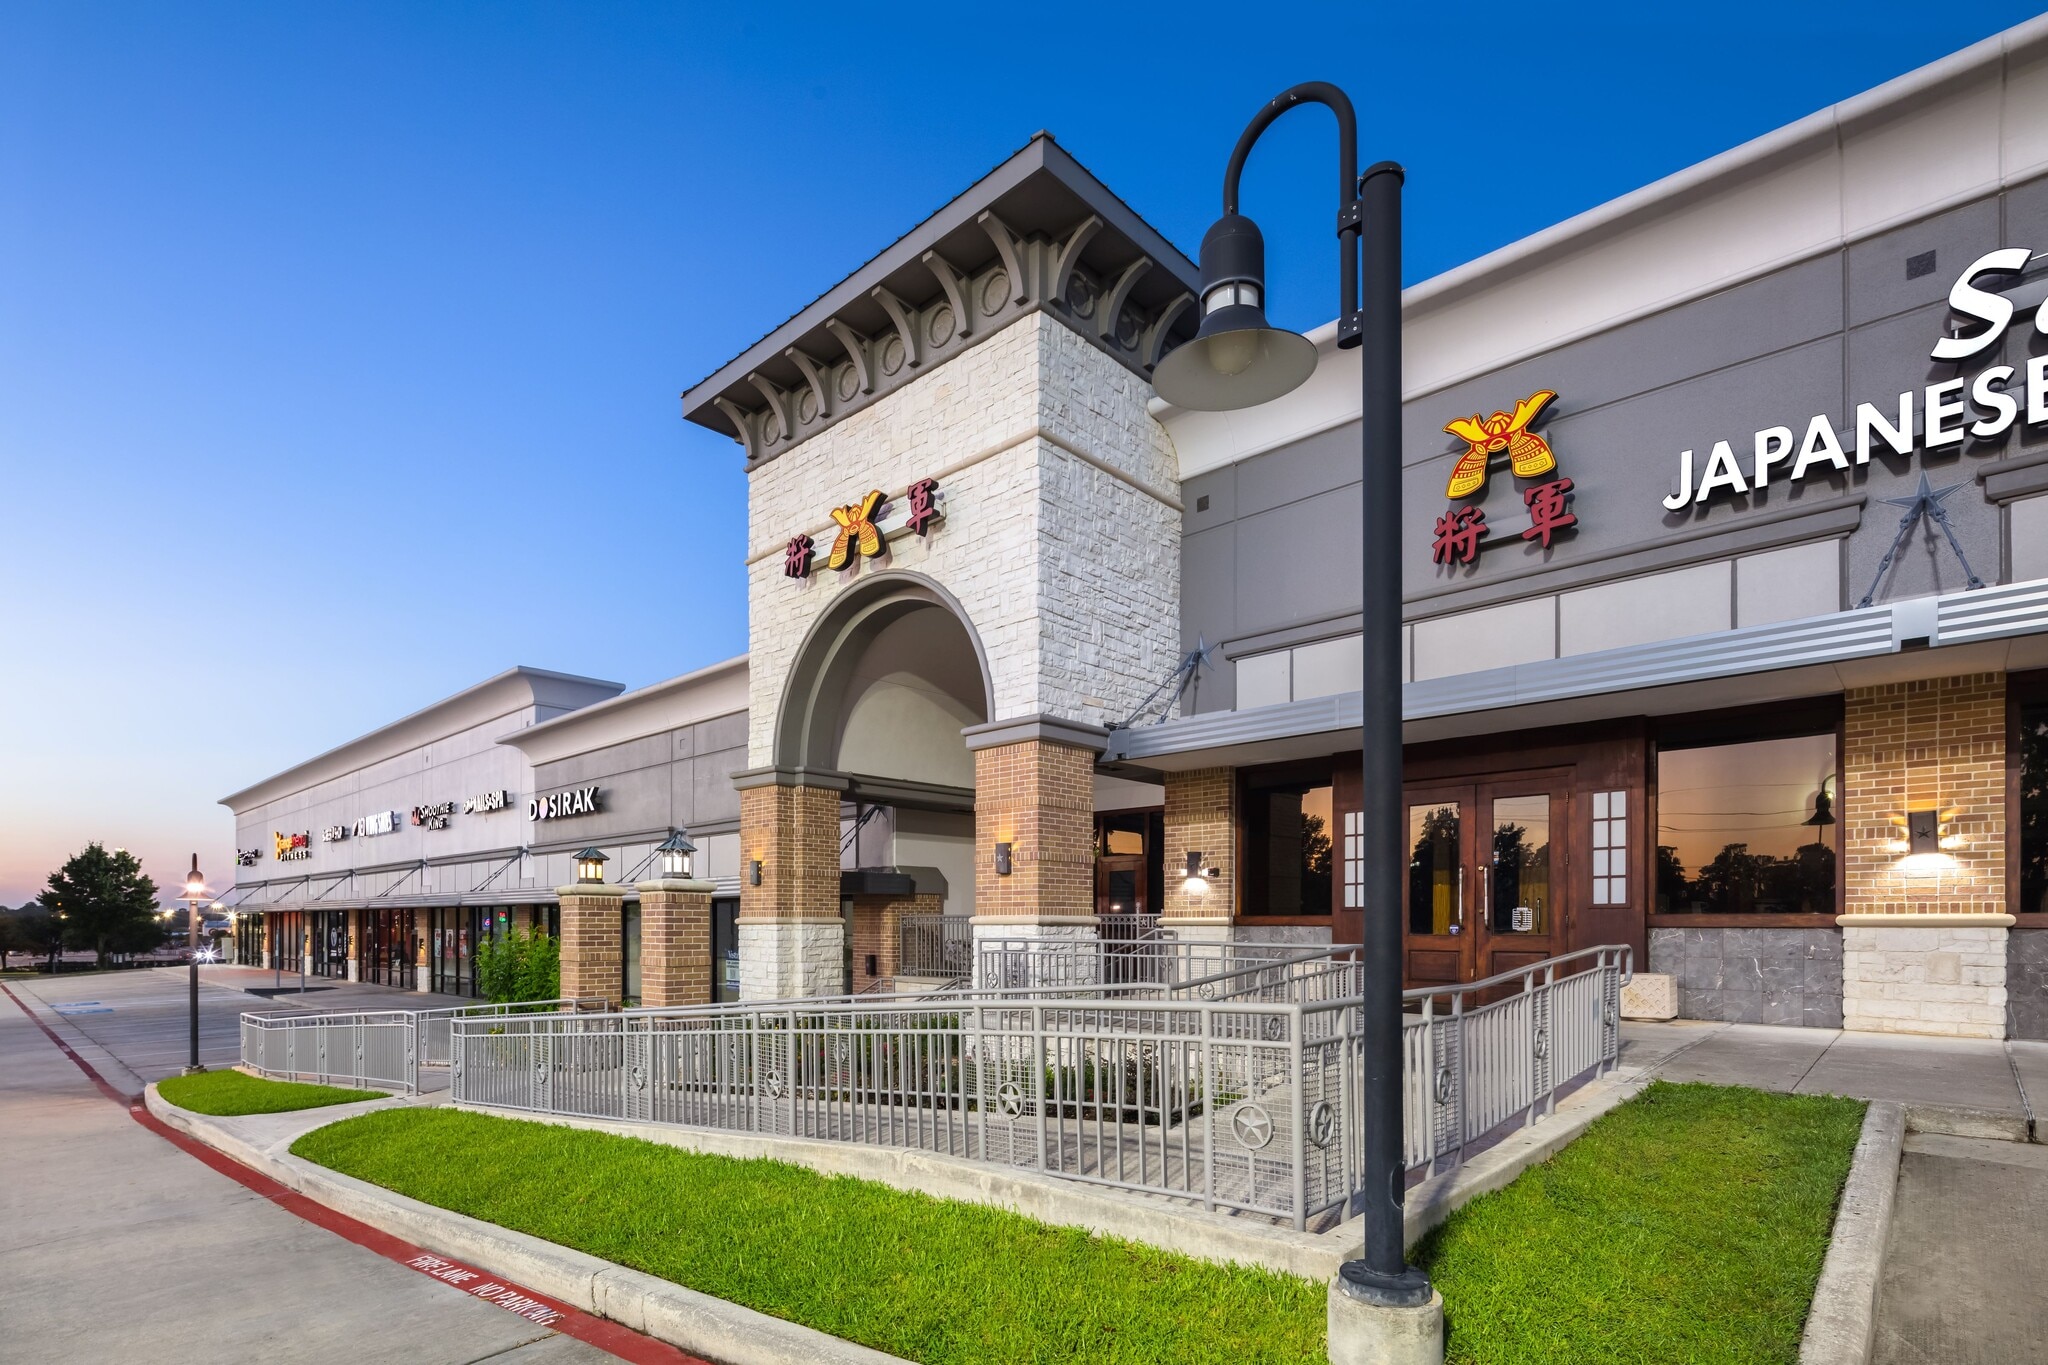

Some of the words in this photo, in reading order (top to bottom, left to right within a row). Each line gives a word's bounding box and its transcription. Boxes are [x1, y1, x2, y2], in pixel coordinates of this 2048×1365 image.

[1929, 247, 2048, 362] S
[420, 802, 450, 819] SMOOTHIE
[528, 786, 597, 822] DOSIRAK
[428, 816, 444, 830] KING
[405, 1255, 449, 1271] FIRE
[430, 1265, 480, 1284] LANE
[469, 1282, 506, 1297] NO
[492, 1290, 565, 1326] PARKING
